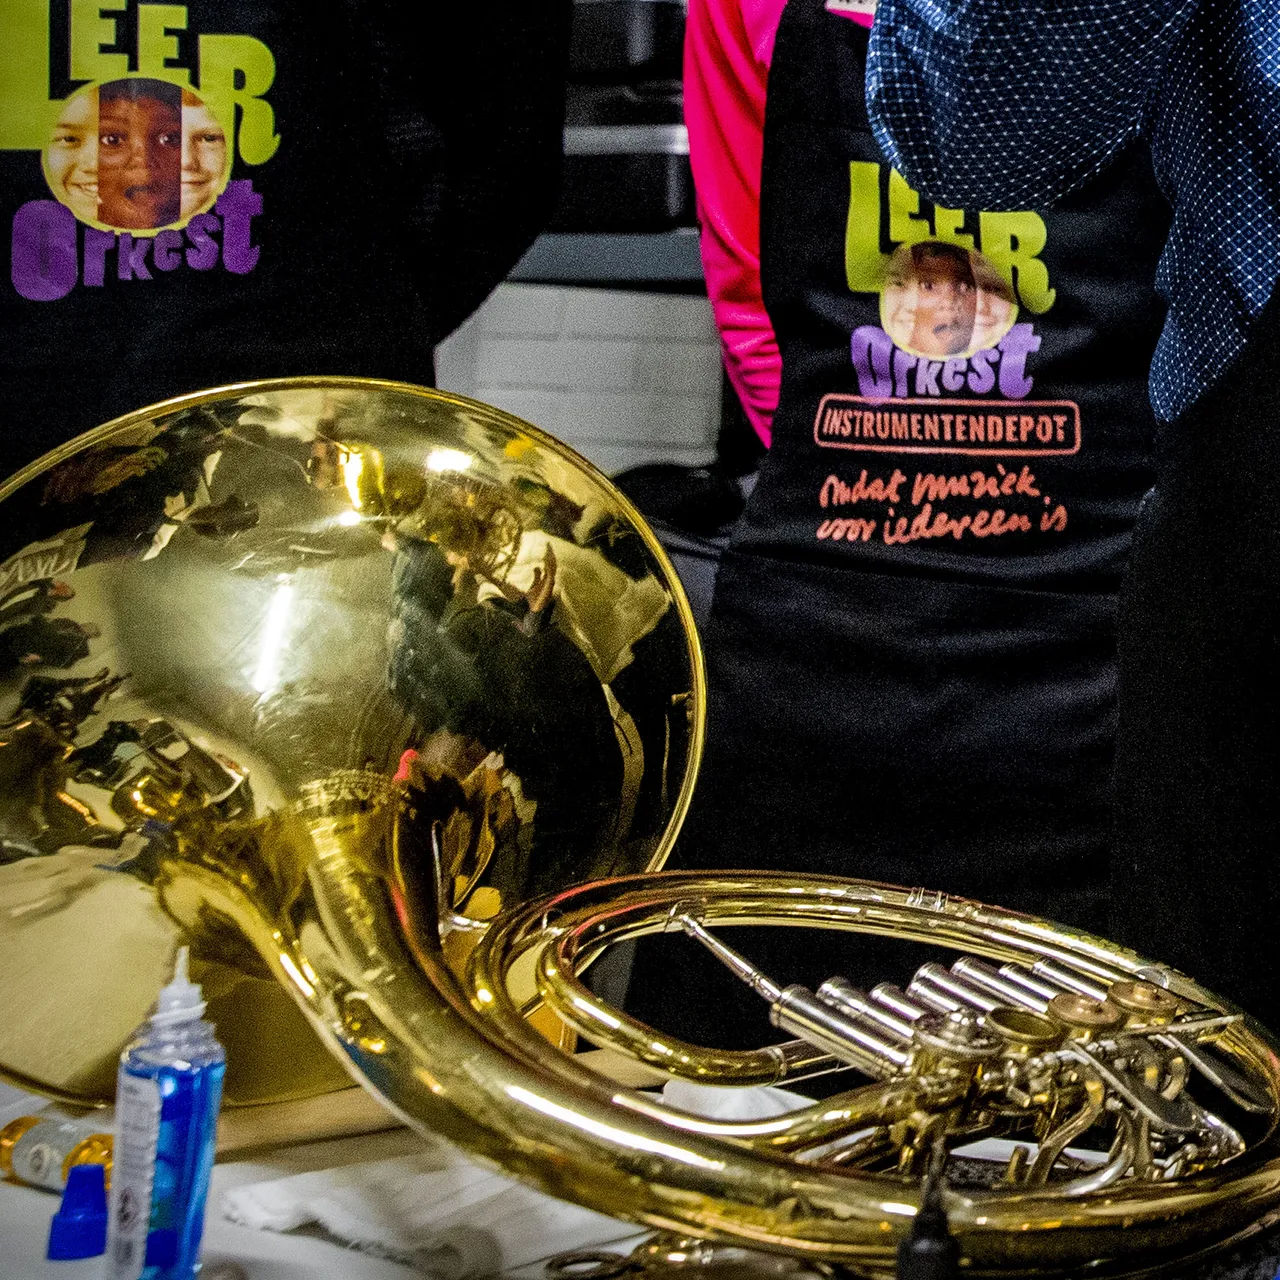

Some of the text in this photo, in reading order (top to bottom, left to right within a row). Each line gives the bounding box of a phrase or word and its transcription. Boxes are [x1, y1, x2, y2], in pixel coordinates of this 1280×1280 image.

[10, 179, 264, 301] Orkest
[845, 161, 1056, 314] LEER
[851, 323, 1041, 406] Orkest
[822, 407, 1068, 444] INSTRUMENTENDEPOT
[911, 463, 1041, 505] muziek
[815, 495, 1068, 545] voor iedereen is
